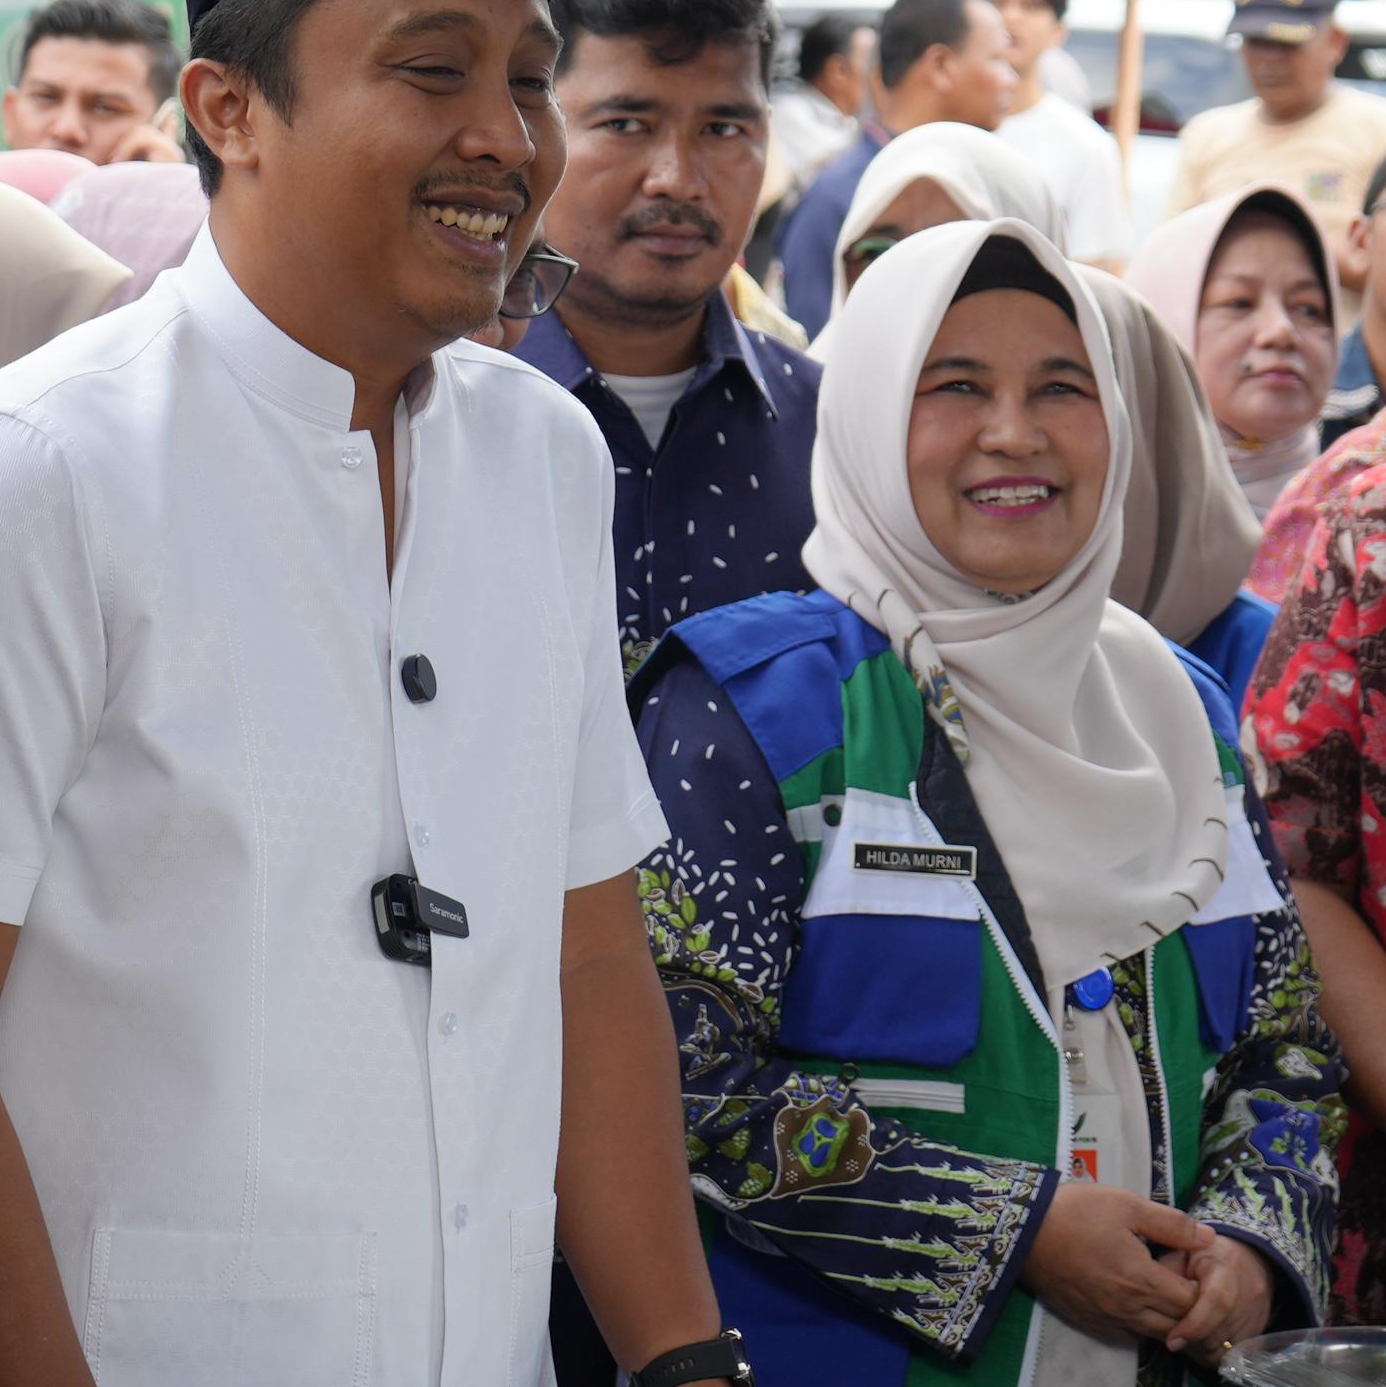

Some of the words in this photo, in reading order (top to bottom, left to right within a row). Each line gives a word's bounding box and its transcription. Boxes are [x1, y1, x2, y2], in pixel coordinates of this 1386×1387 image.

[866, 850, 911, 866] HILDA
[913, 853, 961, 869] MURNI
[429, 902, 464, 924] Saramonic
